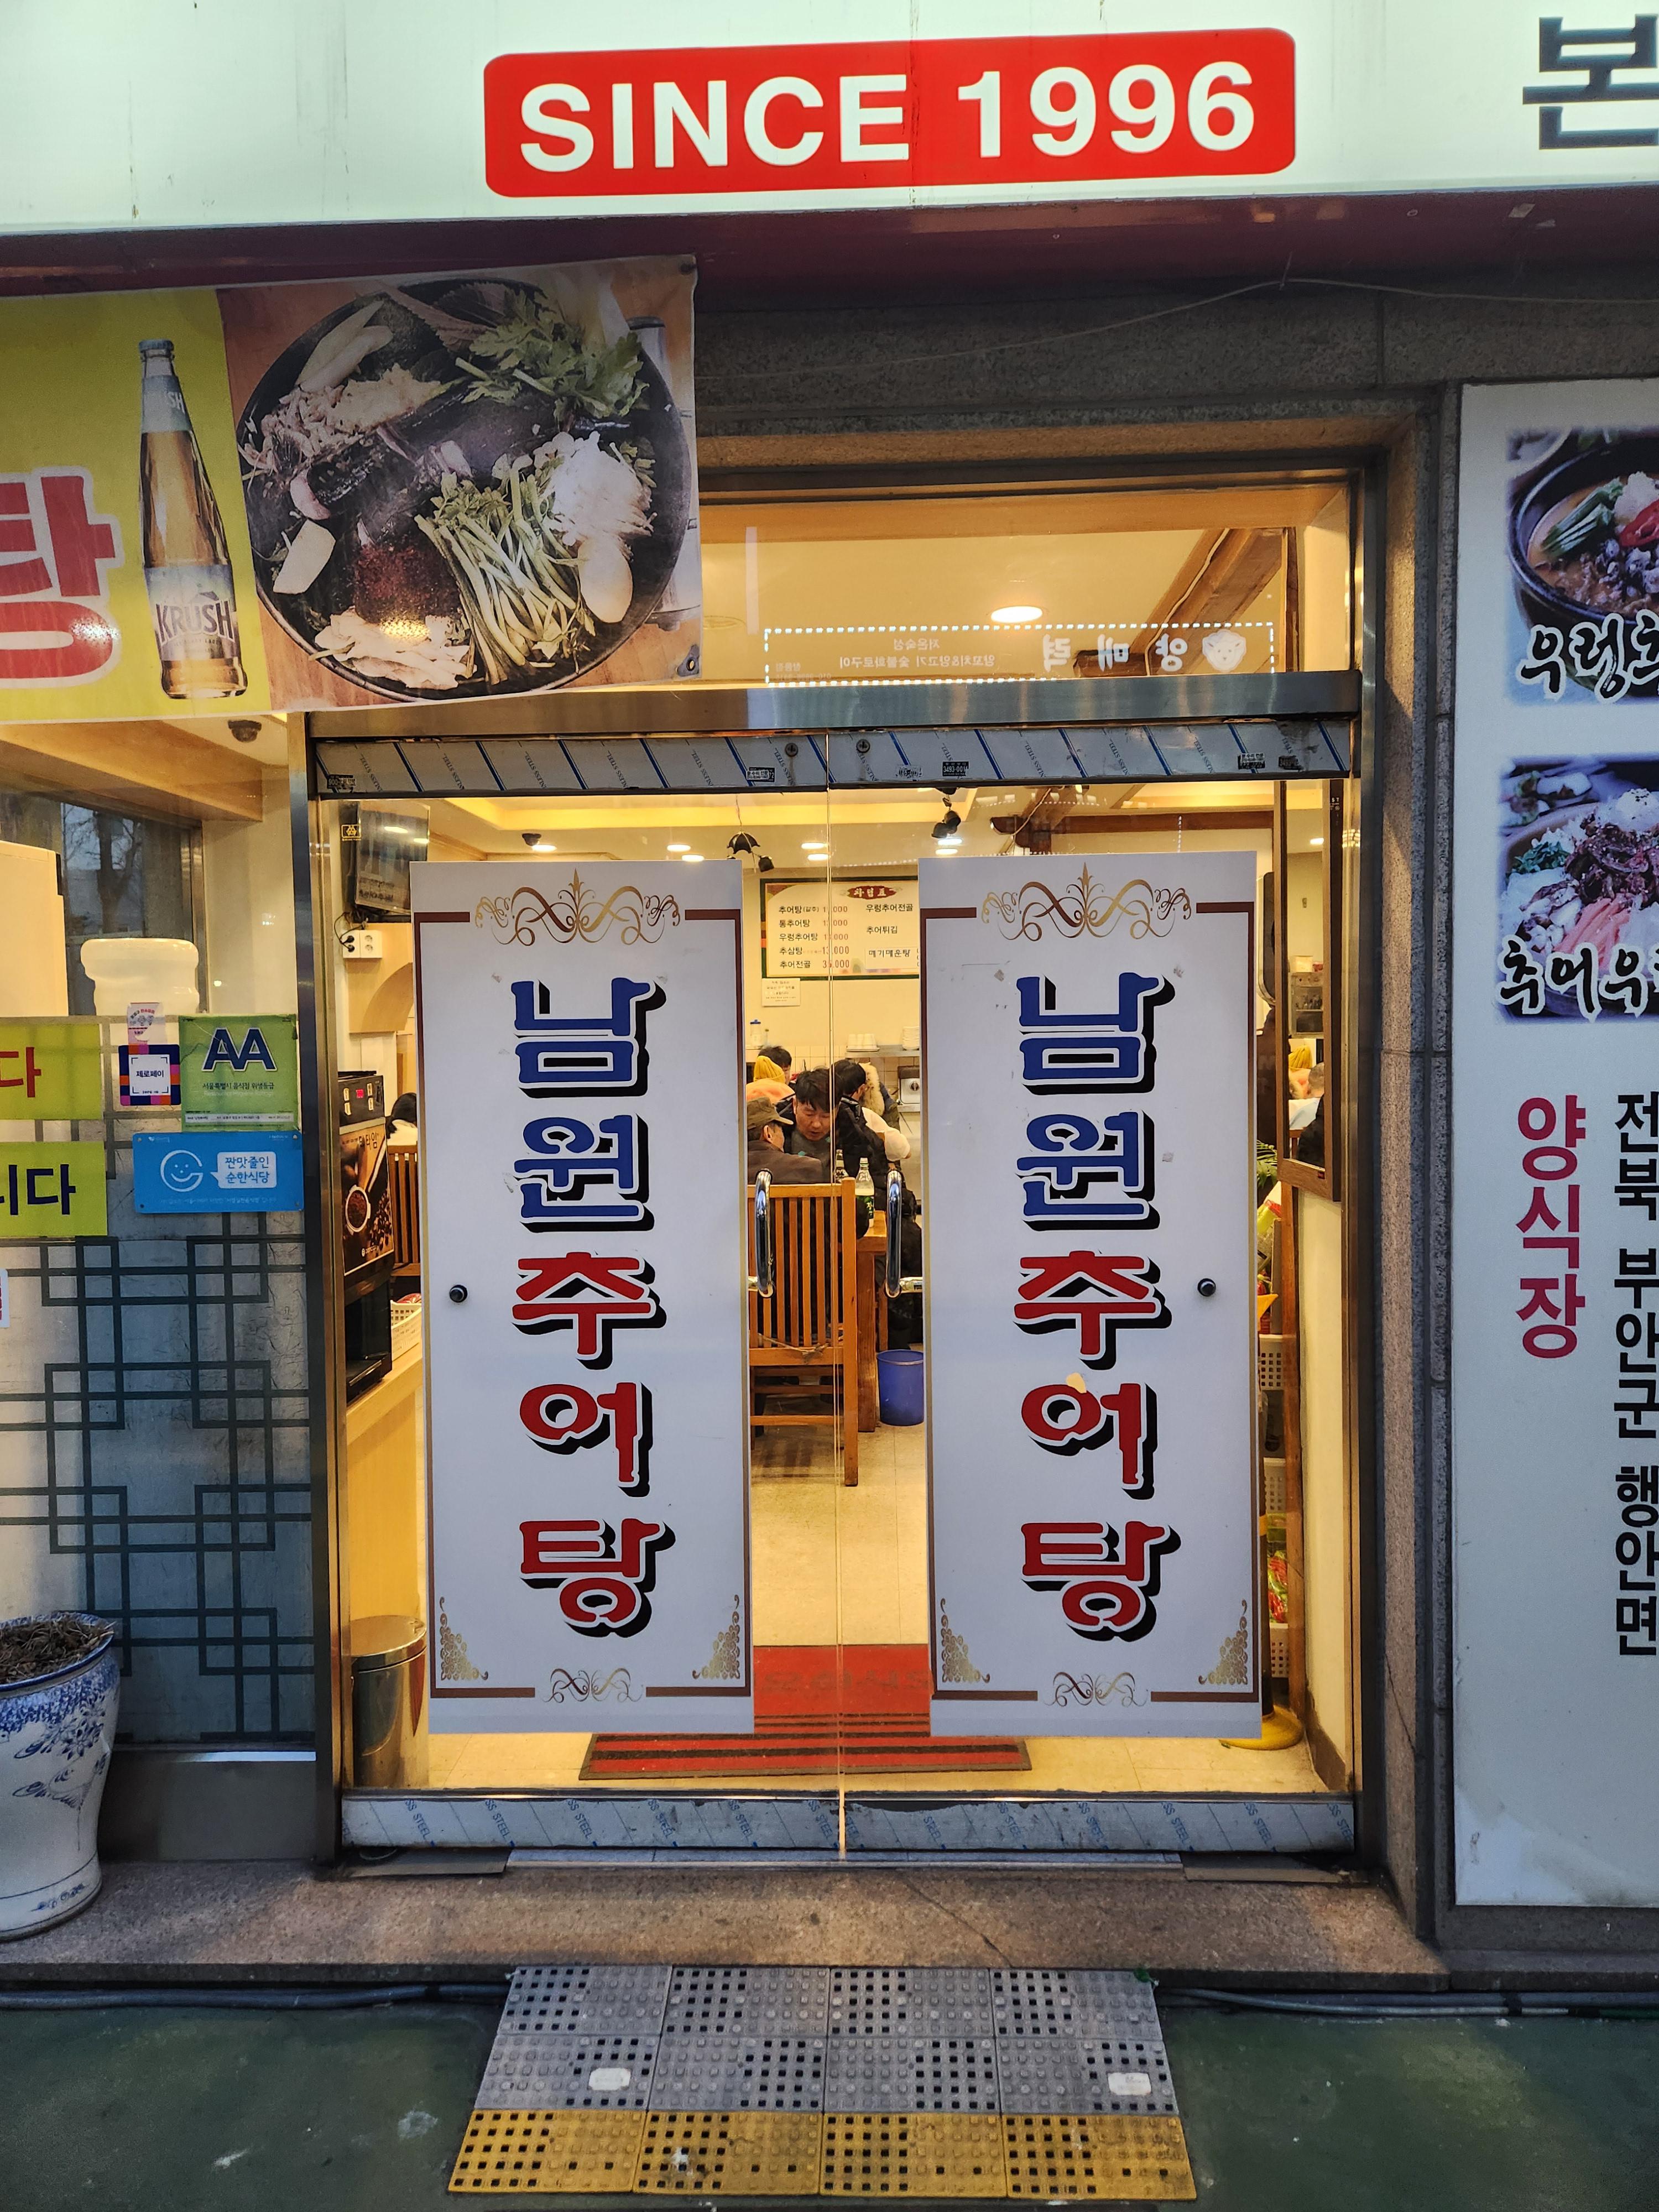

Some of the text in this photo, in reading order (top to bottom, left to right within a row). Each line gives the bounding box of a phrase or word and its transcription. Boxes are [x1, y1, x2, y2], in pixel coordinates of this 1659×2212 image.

[1522, 14, 1659, 150] 본
[520, 61, 1255, 173] SINCE 1996
[155, 599, 235, 645] KRUSH
[866, 904, 914, 912] 우렁추어전골
[867, 926, 898, 934] 추어튀김
[779, 933, 818, 941] 우렁추어탕
[868, 949, 910, 958] 메기매운탕
[779, 960, 811, 968] 추어전골
[1500, 940, 1659, 1014] 추어우
[202, 1027, 277, 1072] AA
[0, 1047, 41, 1098] 다
[136, 1070, 164, 1078] 제로페이
[225, 1156, 269, 1169] 짠맛줄인
[226, 1171, 270, 1184] 순한식당
[1515, 1094, 1587, 1359] 양식장
[510, 977, 676, 1638] 남원추어탕
[1013, 972, 1181, 1642] 남원추어탕
[1614, 1091, 1659, 1656] 전북 부안군 행안면
